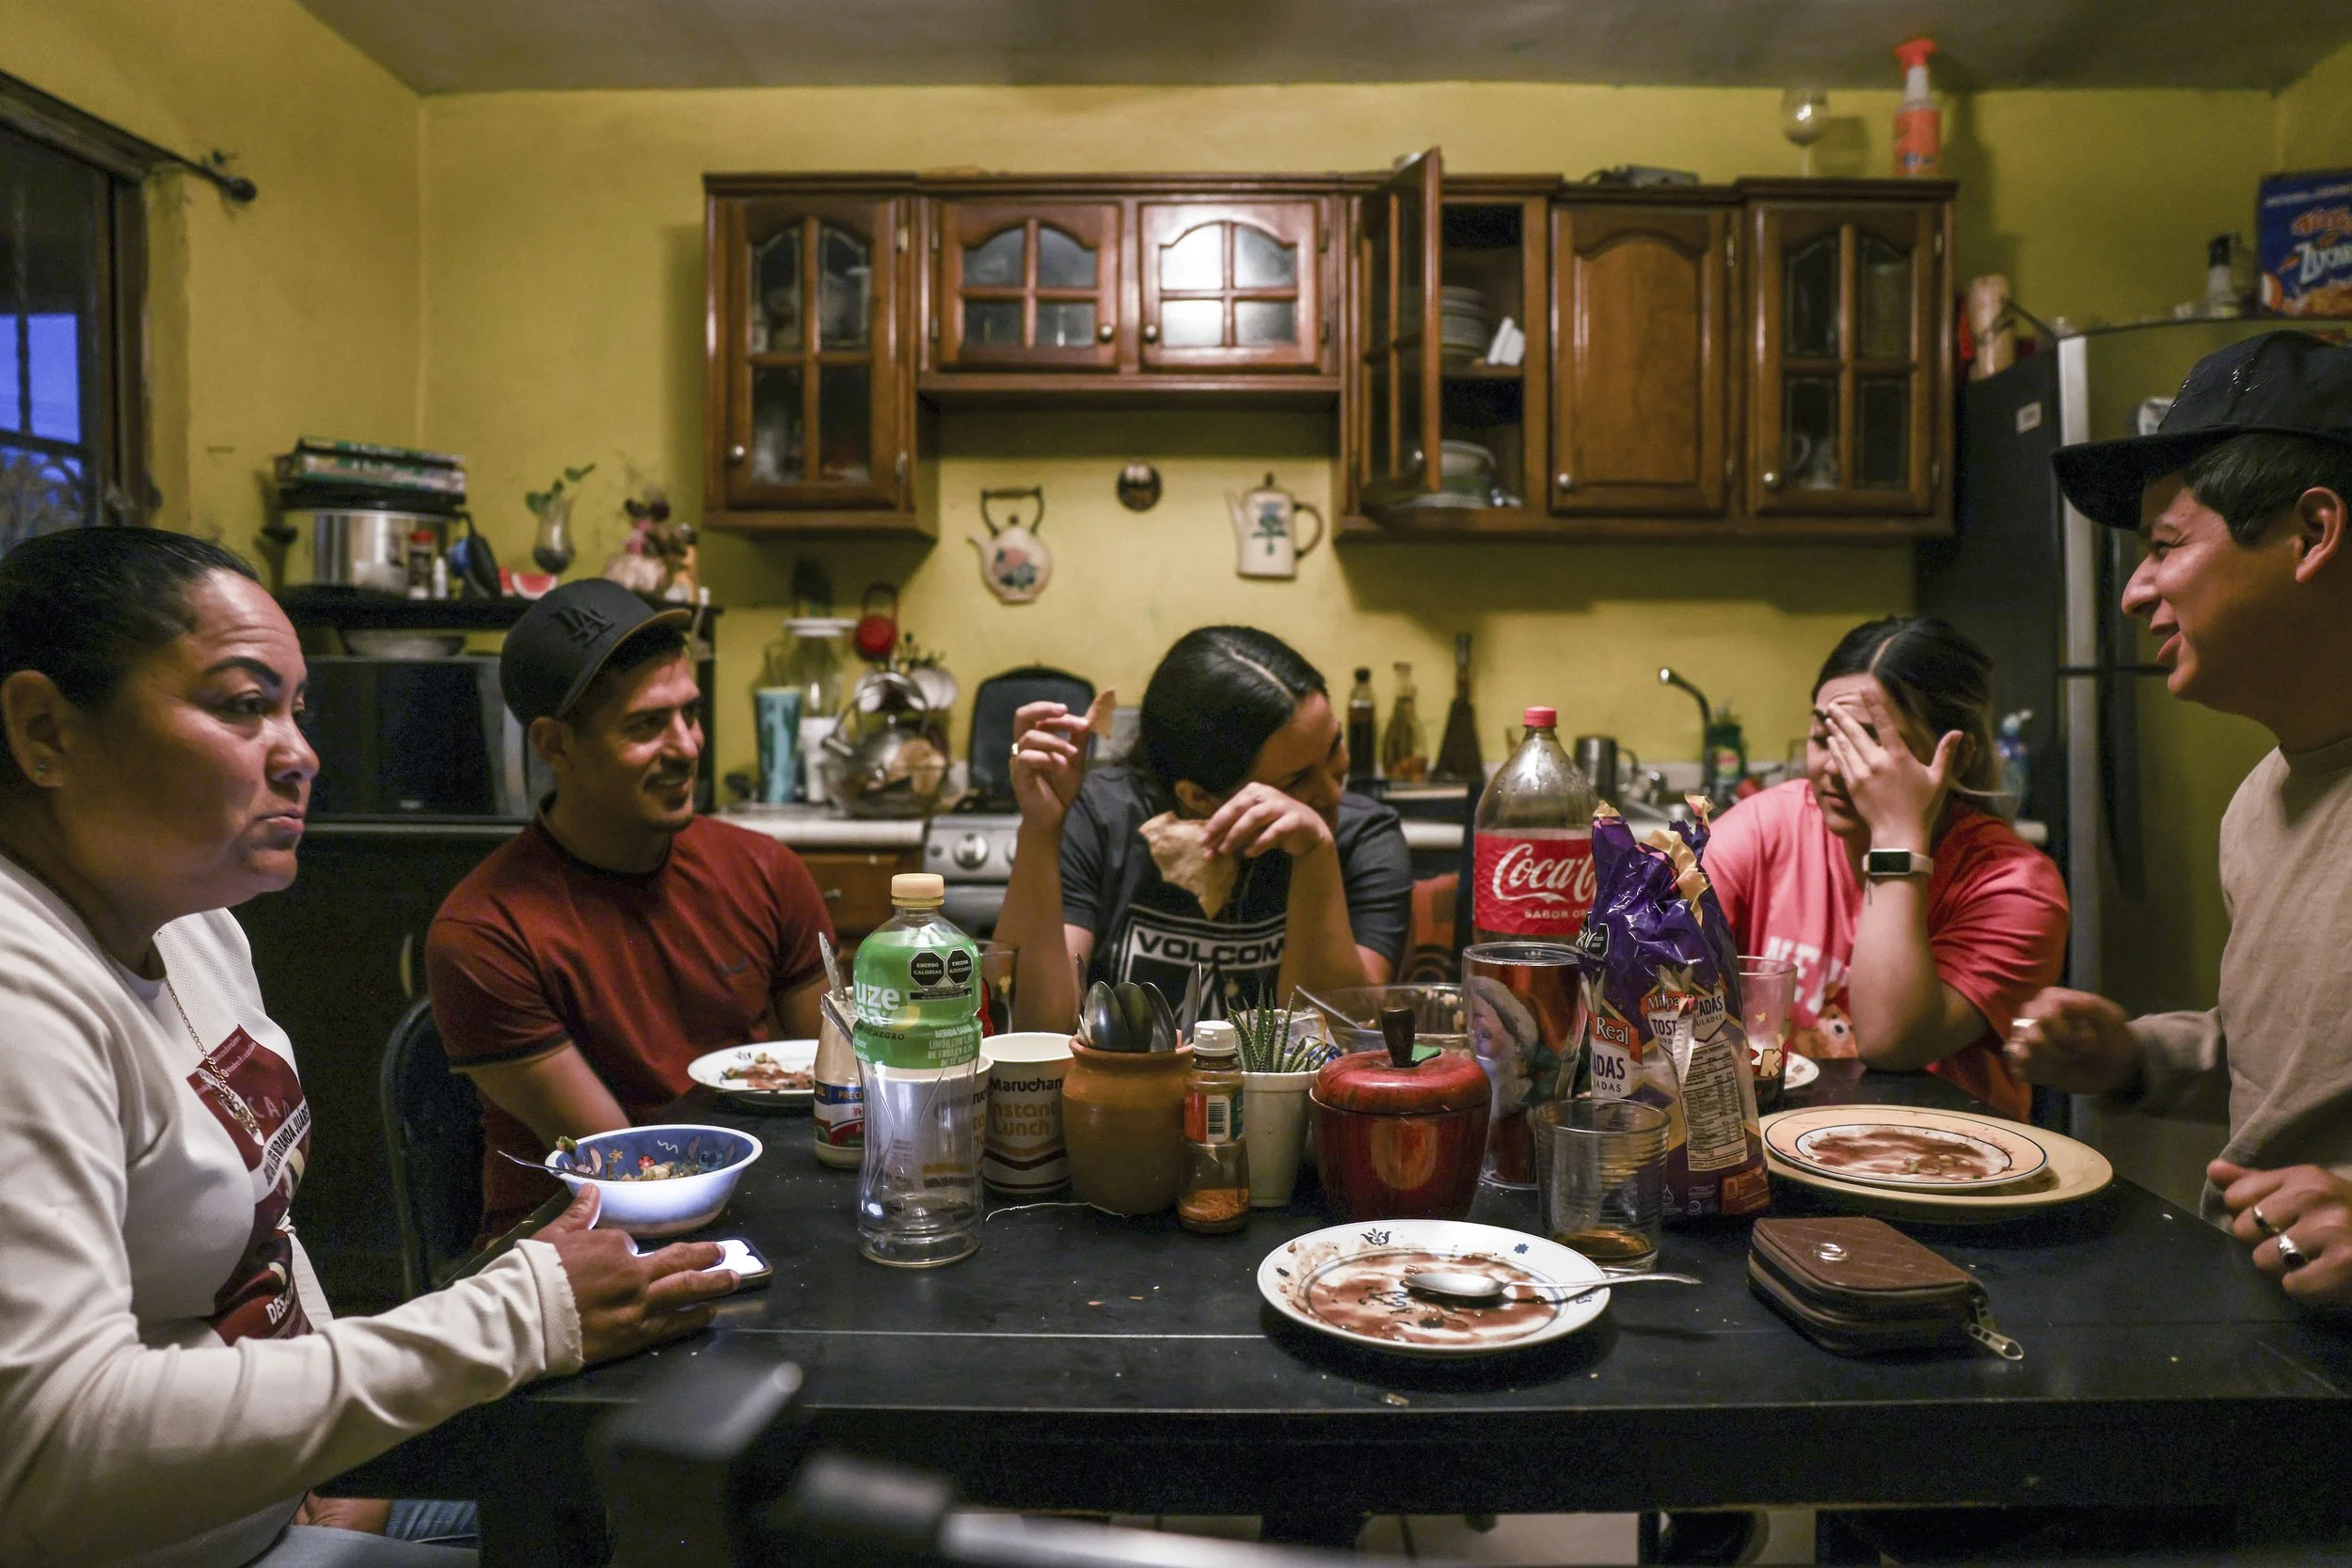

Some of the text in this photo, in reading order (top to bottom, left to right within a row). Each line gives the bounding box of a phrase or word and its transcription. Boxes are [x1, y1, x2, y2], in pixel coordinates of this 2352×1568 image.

[1524, 910, 1568, 919] SABOR
[1136, 930, 1284, 965] VOLCOM
[1647, 993, 1679, 1012] Milpa
[872, 1031, 905, 1040] NEGRO
[1596, 1017, 1629, 1045] Real
[989, 1077, 1063, 1093] Maruchan
[838, 1090, 863, 1100] PRECI
[992, 1100, 1057, 1118] nstant
[993, 1114, 1051, 1137] Lunch
